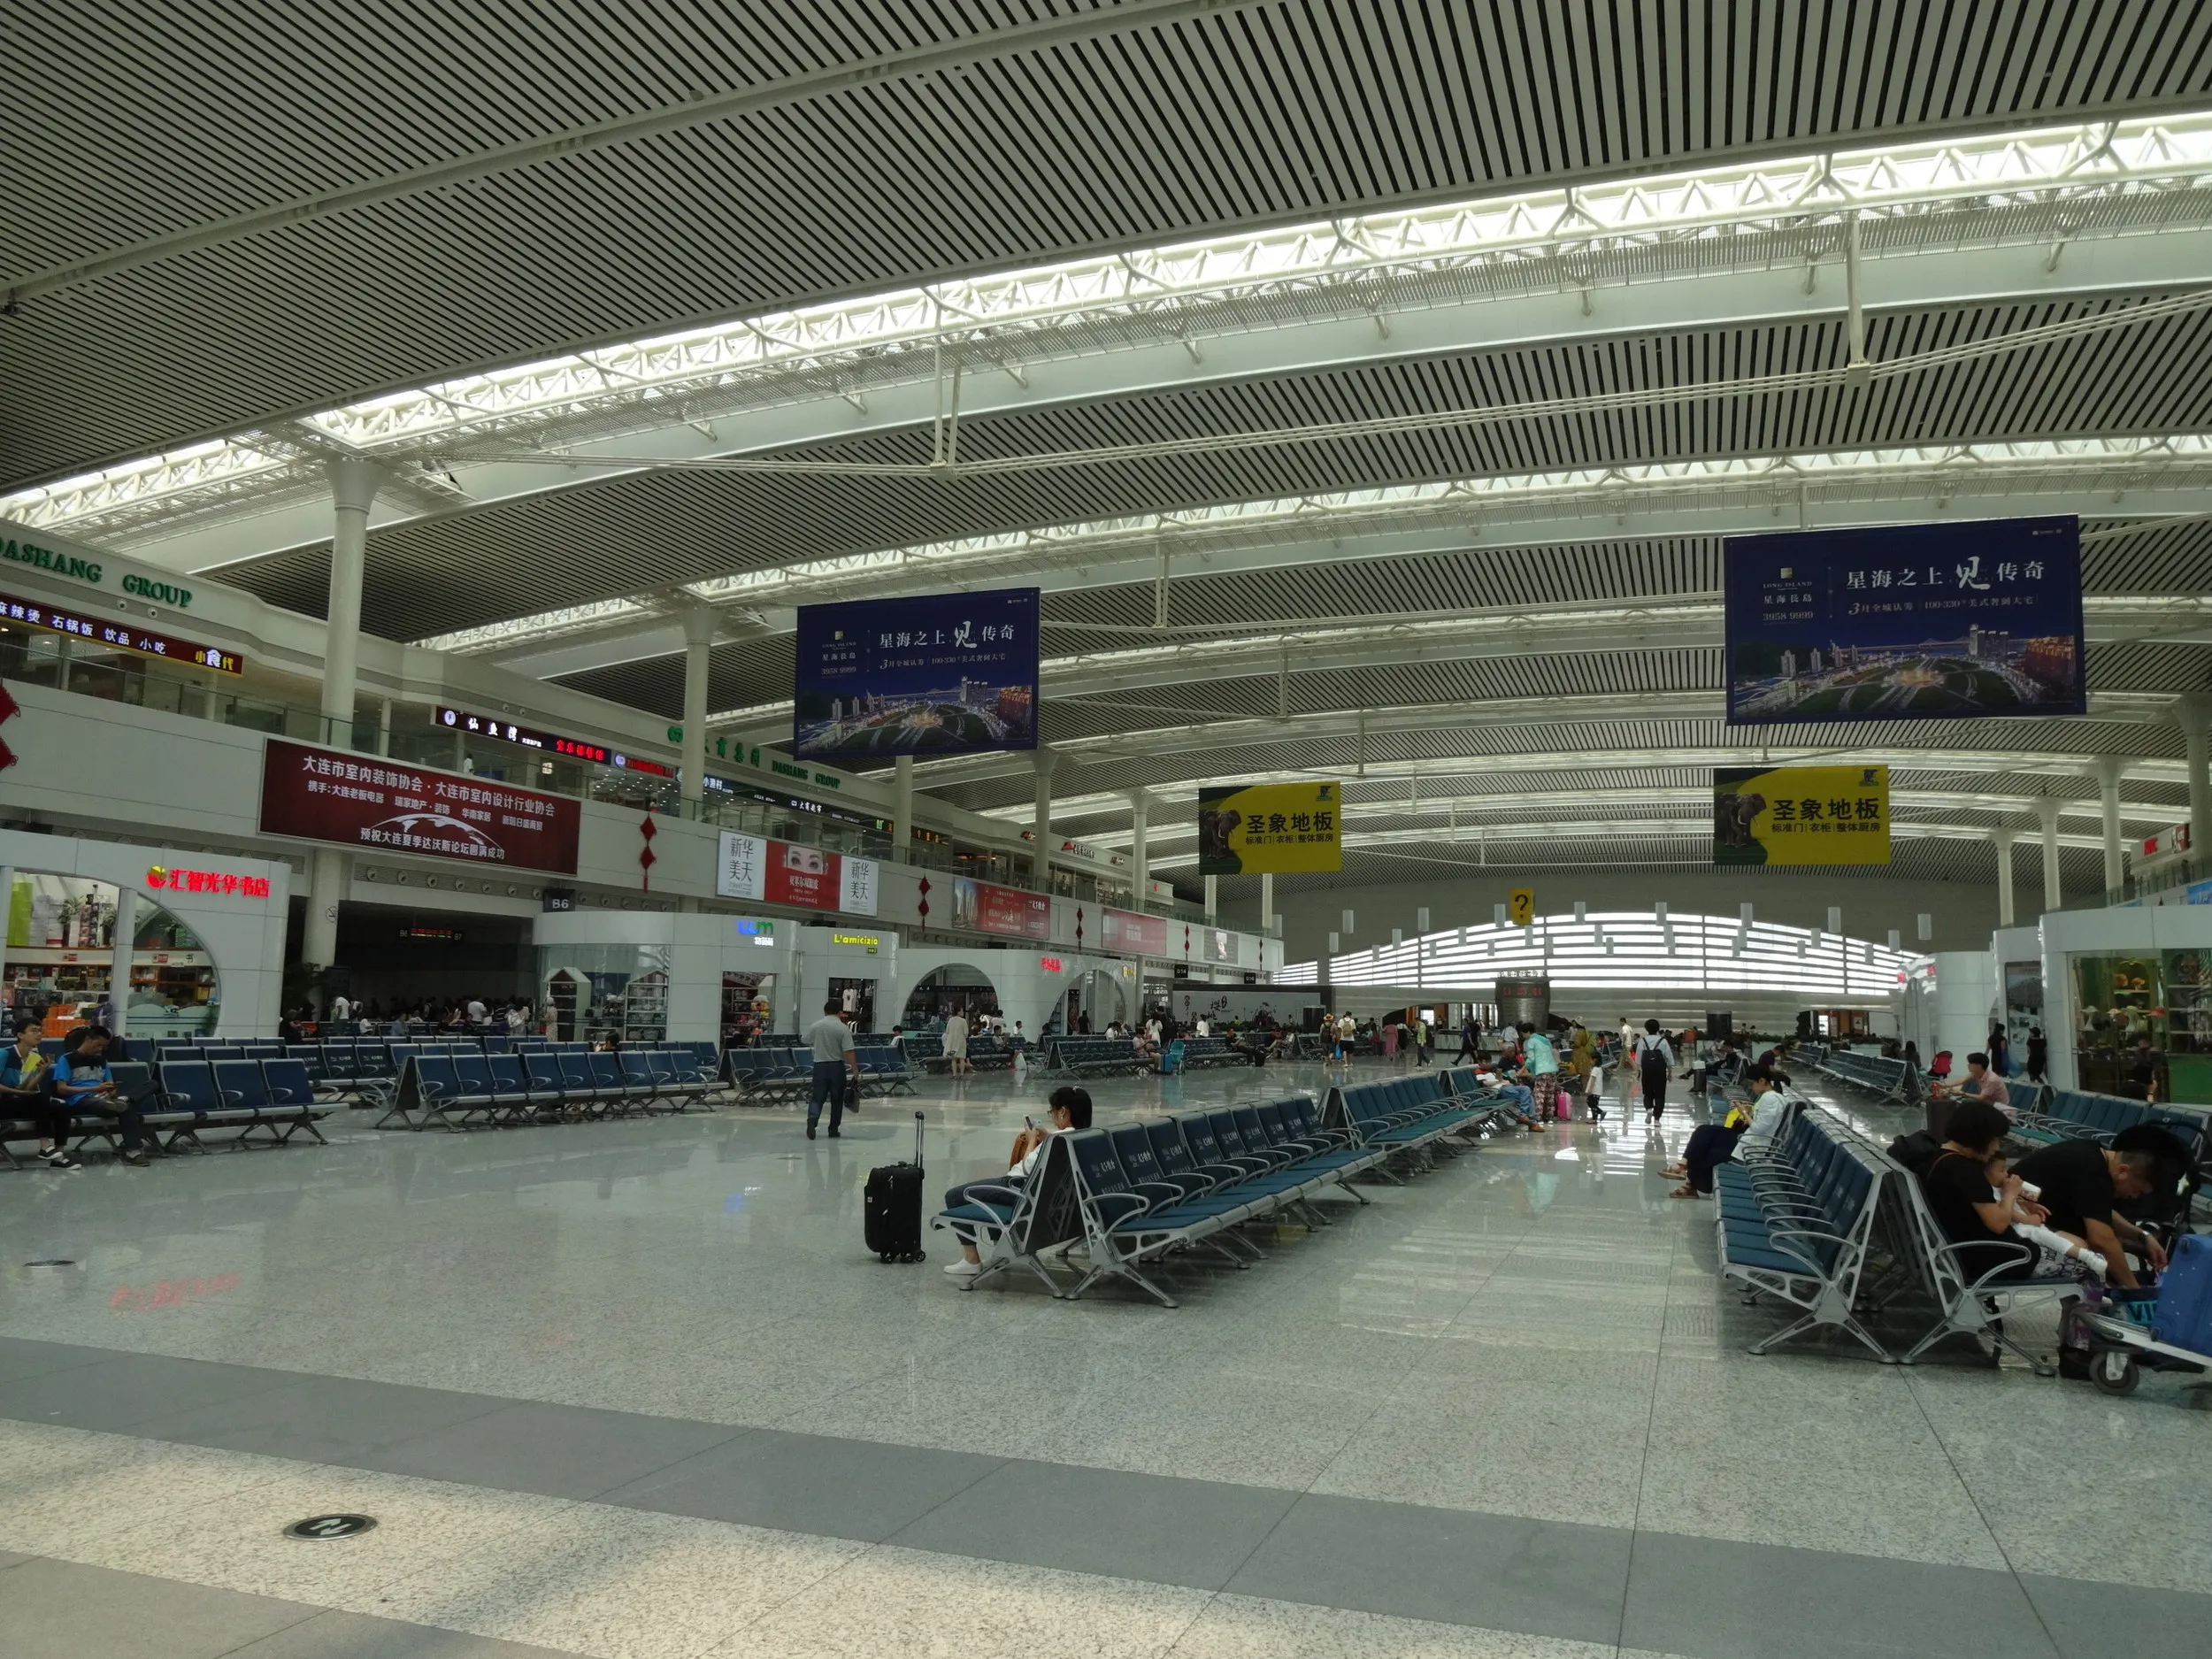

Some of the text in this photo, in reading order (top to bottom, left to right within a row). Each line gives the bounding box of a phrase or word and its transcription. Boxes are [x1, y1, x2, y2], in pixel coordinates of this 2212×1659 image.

[122, 574, 193, 608] GROUP
[51, 615, 94, 637] 石锅饭
[104, 627, 130, 645] 饮品
[140, 638, 166, 656] 小吃
[705, 736, 760, 768] 商集团
[772, 759, 841, 789] DASHANG GROUP
[1772, 797, 1880, 821] 圣象地板
[1246, 810, 1334, 834] 圣象地板
[730, 836, 754, 859] 新华
[729, 859, 753, 882] 美天
[851, 861, 869, 880] 新华
[850, 880, 869, 900] 美天
[552, 898, 569, 910] B6
[833, 933, 879, 946] L'amicizia
